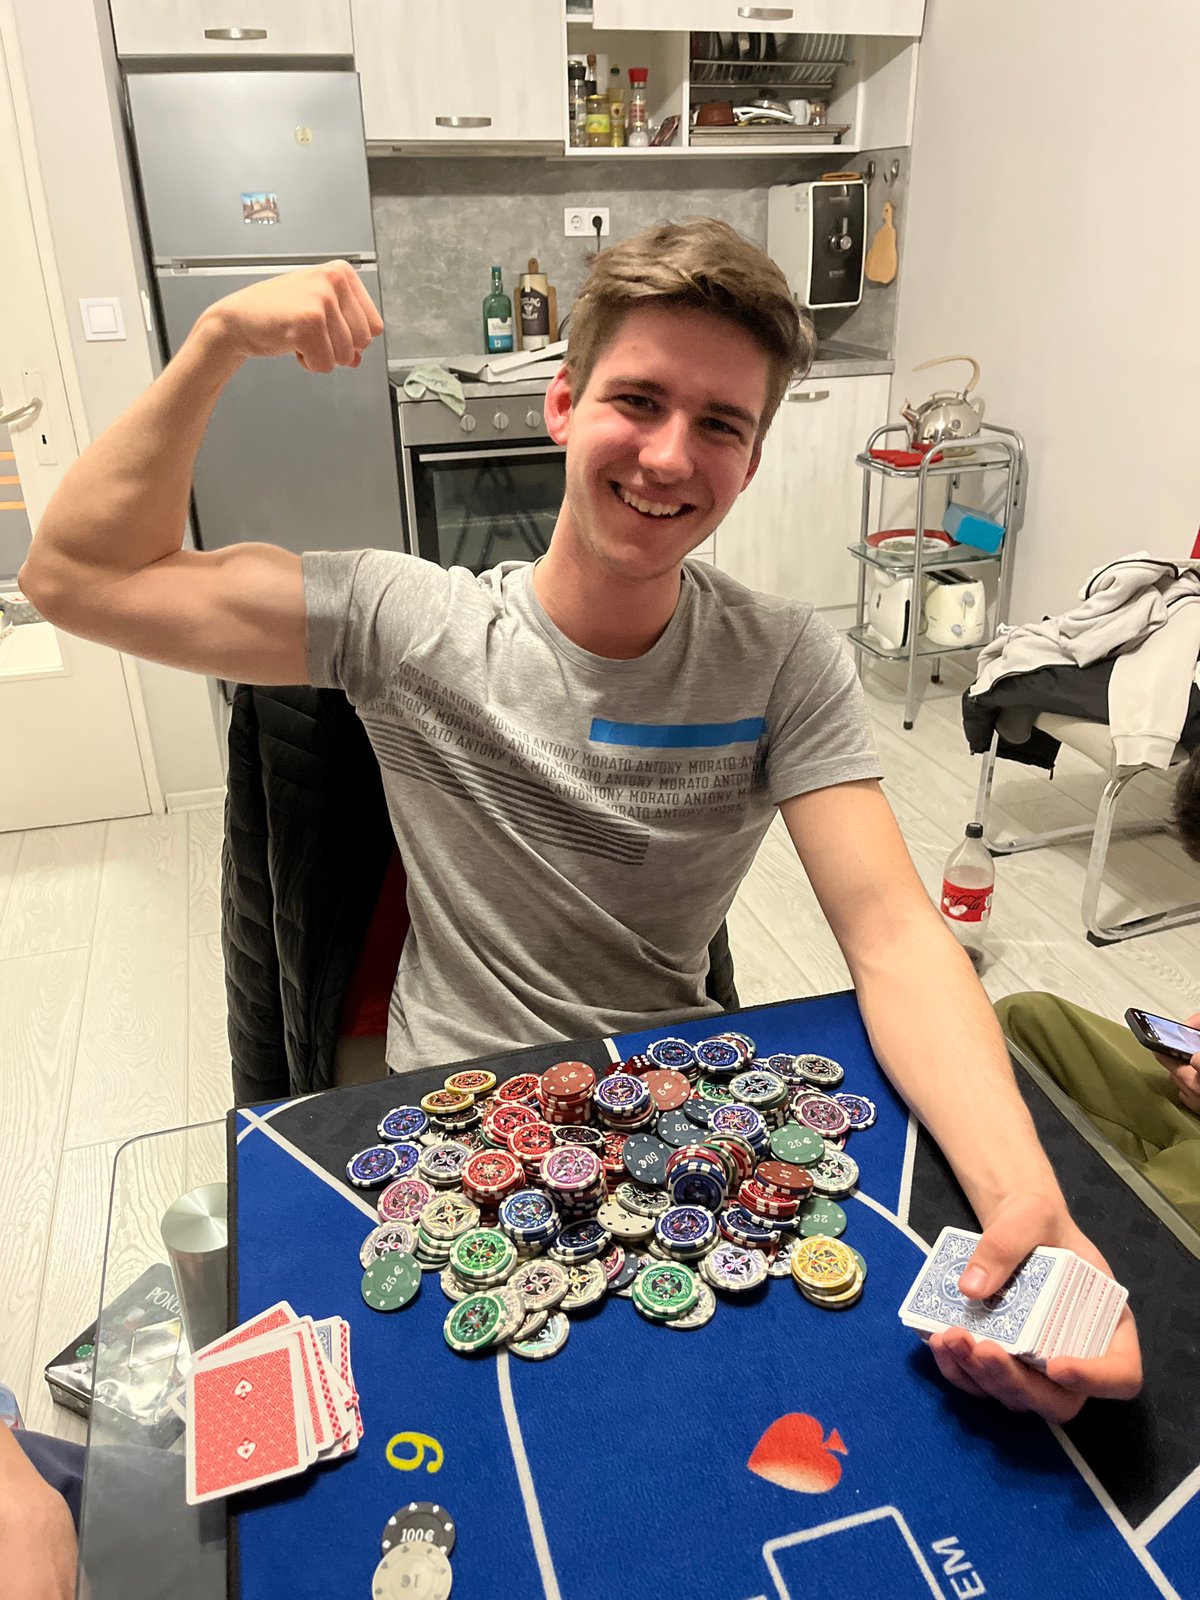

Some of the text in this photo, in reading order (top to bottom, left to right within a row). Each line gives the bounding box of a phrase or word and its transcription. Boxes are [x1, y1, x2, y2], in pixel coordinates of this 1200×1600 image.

[413, 718, 452, 743] ORATO
[455, 735, 507, 760] ANTONY
[554, 783, 598, 802] ANTON
[607, 803, 650, 819] ORATO
[434, 709, 485, 738] MORATO
[629, 789, 680, 806] MORATO
[684, 789, 733, 806] ANTONY
[441, 687, 483, 717] ANTONY
[486, 713, 530, 743] MORATO
[533, 738, 579, 761] ANTONY
[582, 752, 632, 772] MORATO
[635, 760, 683, 775] ANTONY
[689, 756, 736, 774] MORATO
[605, 773, 655, 788] ANTONY
[659, 776, 709, 791] MORATO
[713, 772, 753, 789] ANTON
[145, 1286, 182, 1315] POKE
